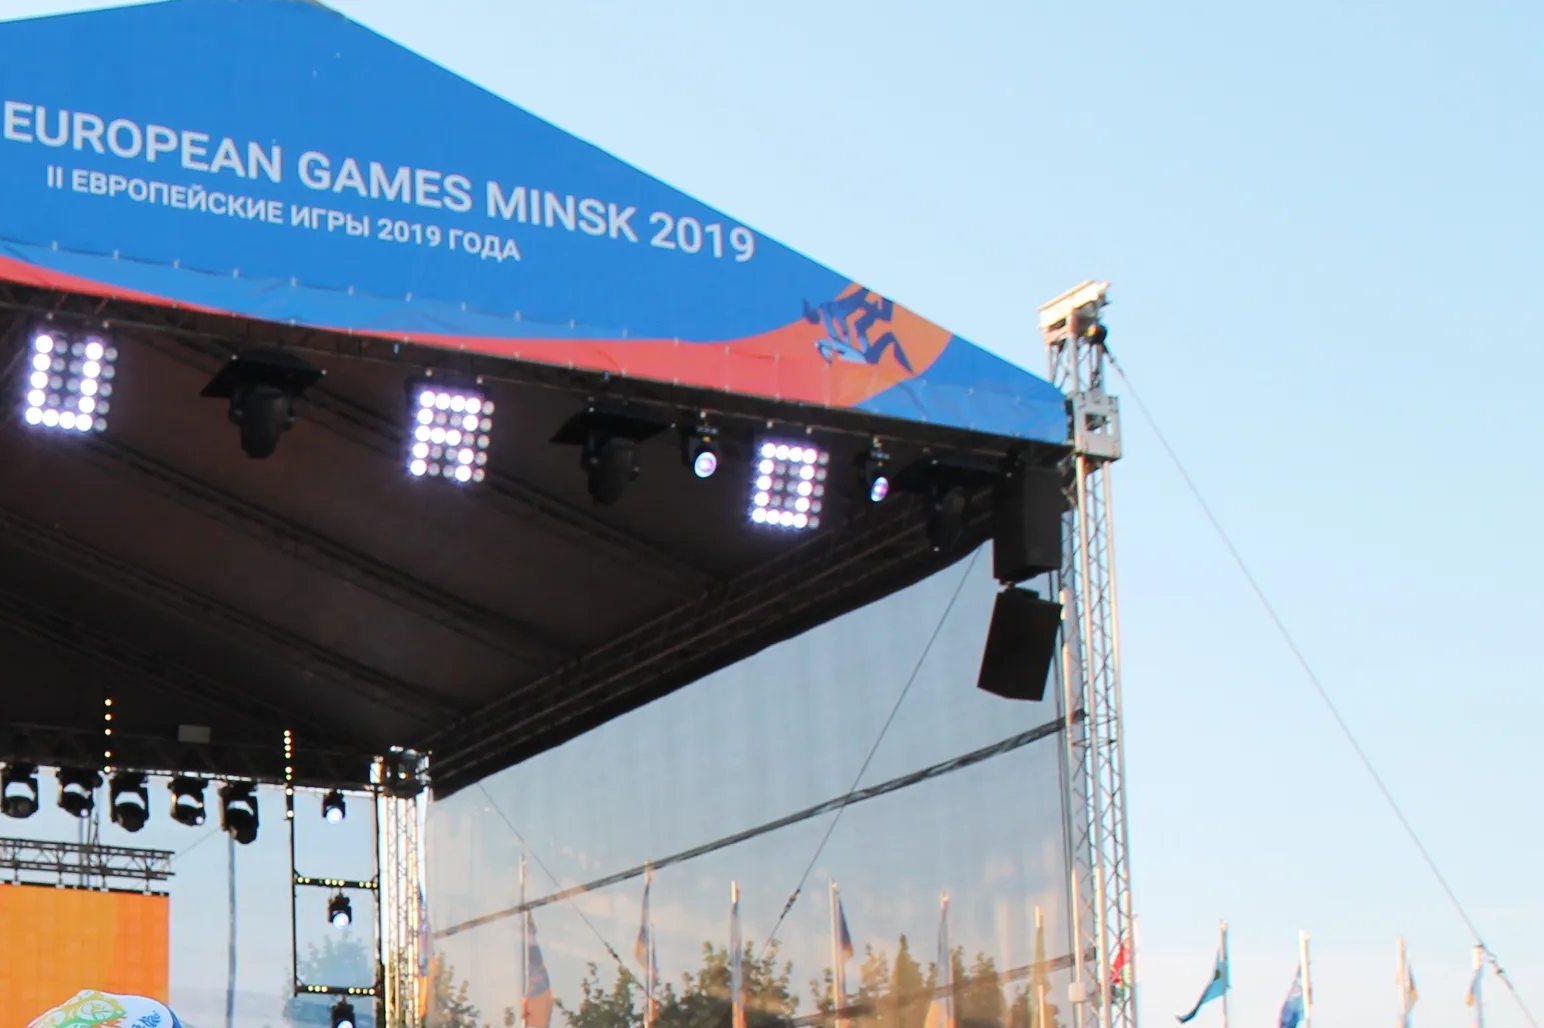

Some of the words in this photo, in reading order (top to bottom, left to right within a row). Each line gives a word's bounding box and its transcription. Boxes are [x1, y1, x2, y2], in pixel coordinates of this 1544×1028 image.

[3, 100, 283, 184] EUROPEAN
[297, 151, 472, 212] GAMES
[486, 181, 639, 244] MINSK
[649, 211, 756, 263] 2019
[71, 168, 284, 225] ЕВРОПЕЙСКИЕ
[291, 204, 370, 238] ИГРЫ
[377, 218, 441, 248] 2019
[448, 228, 521, 263] ГОДА
